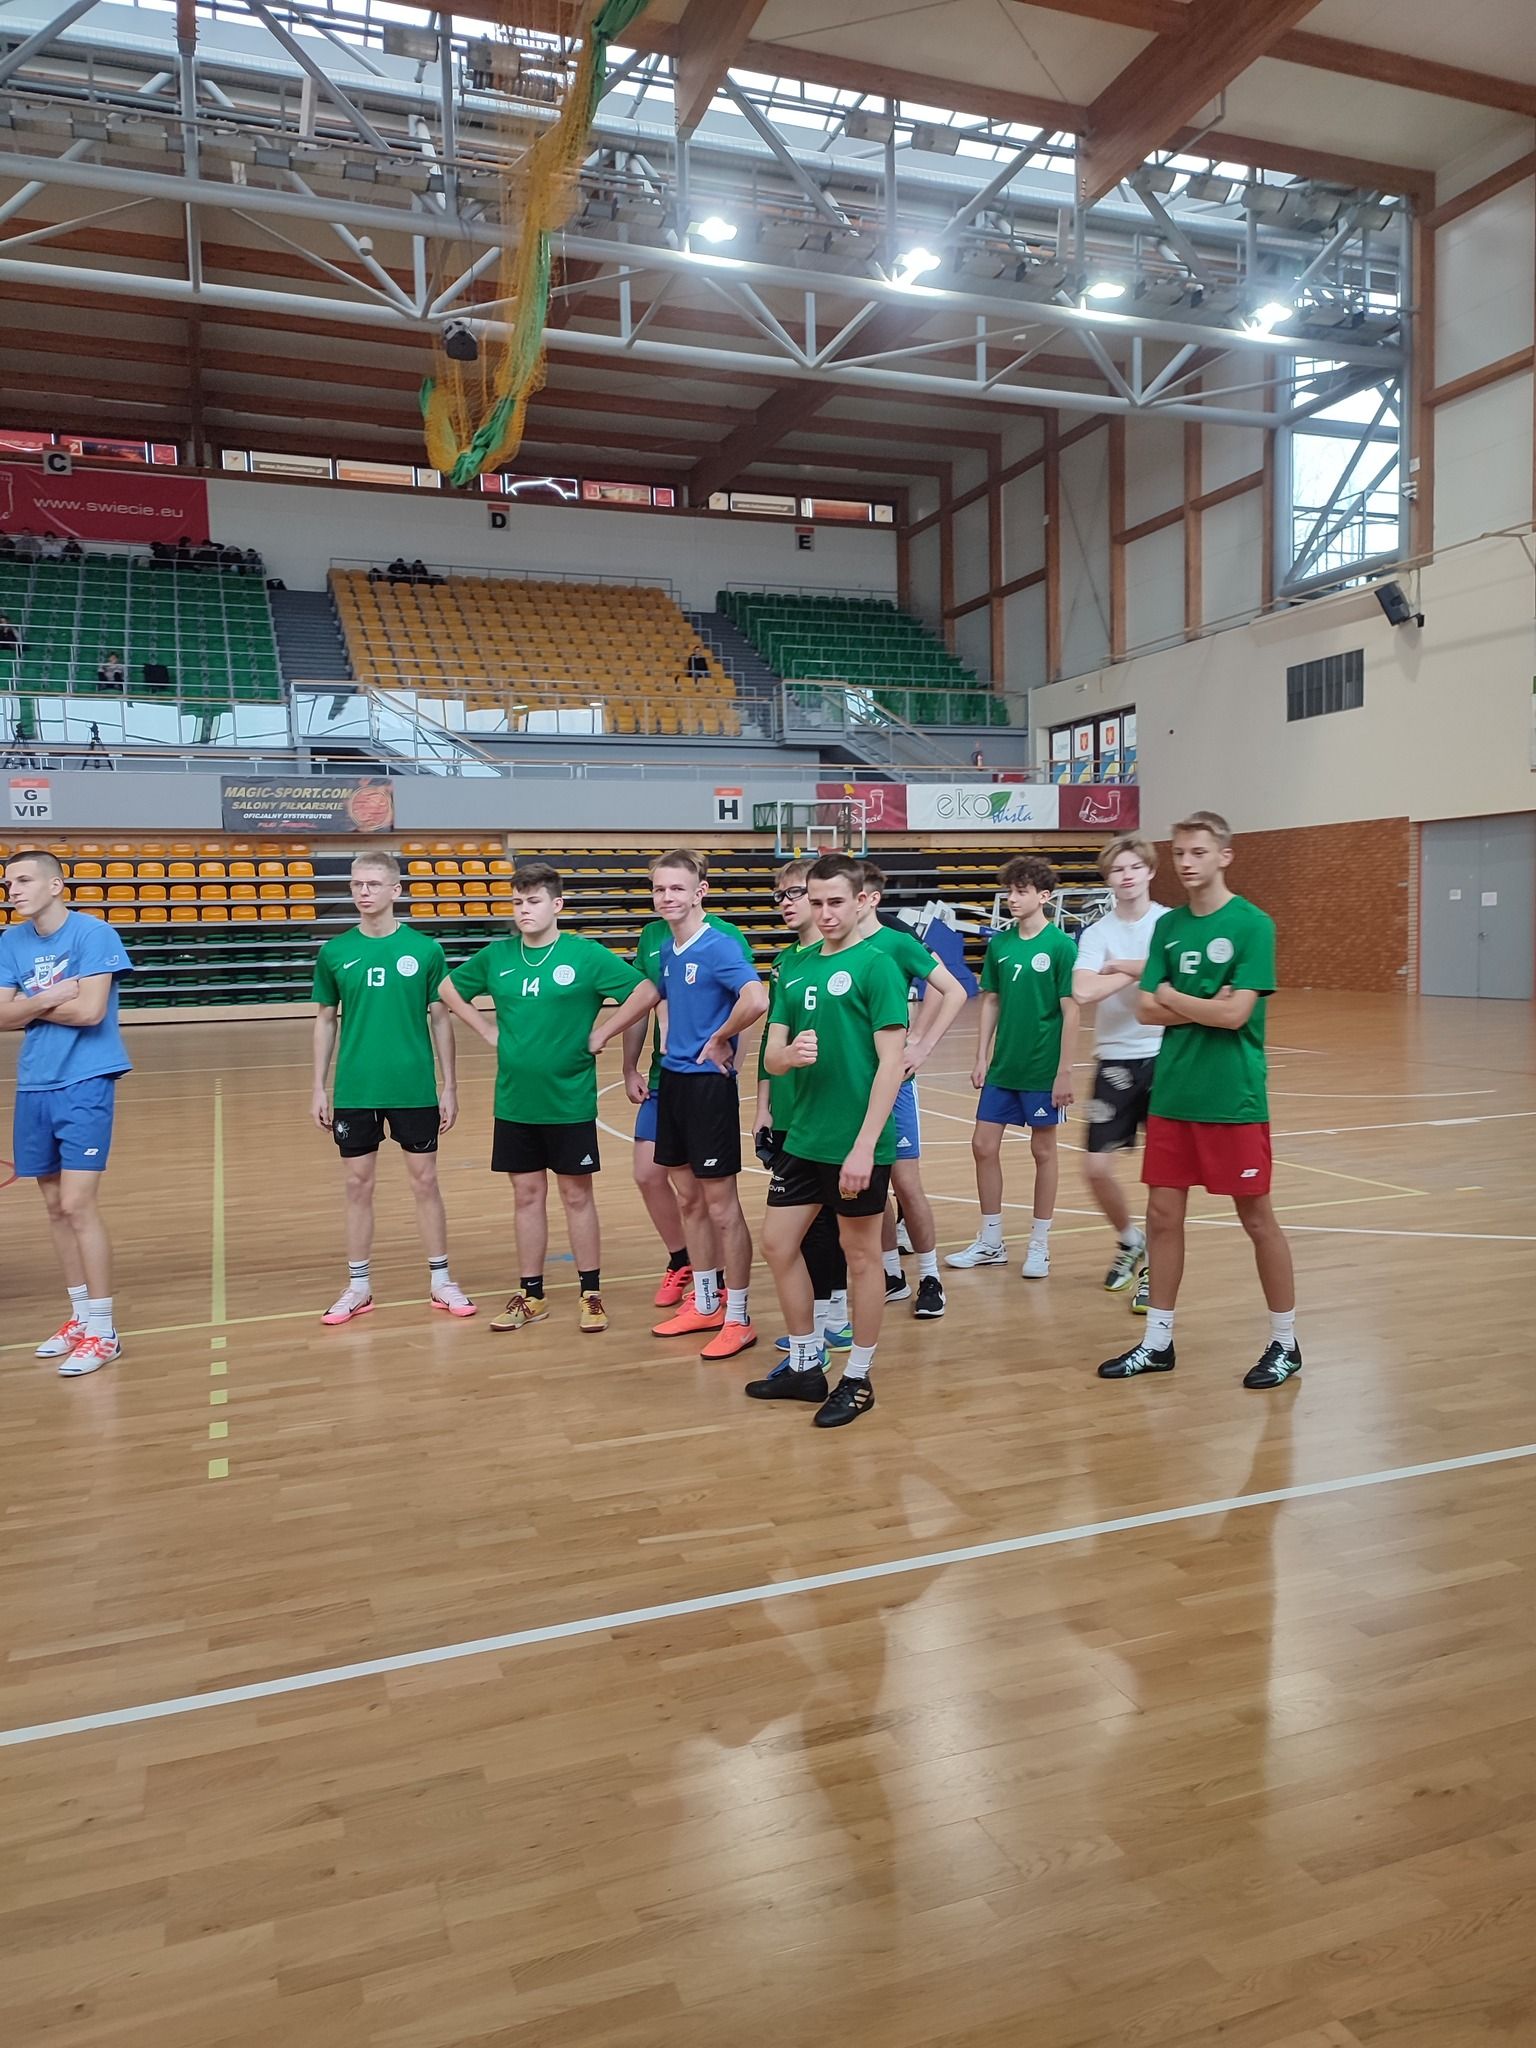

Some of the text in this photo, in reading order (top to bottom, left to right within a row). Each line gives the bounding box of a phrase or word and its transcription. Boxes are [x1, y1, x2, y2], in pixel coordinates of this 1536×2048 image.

[48, 453, 67, 471] C
[33, 498, 184, 518] www.swiecie.eu
[491, 513, 507, 529] D
[799, 535, 811, 549] E
[24, 789, 38, 801] G
[224, 787, 354, 799] MAGIC-SPORT.COM
[14, 805, 48, 817] VIP
[231, 801, 277, 810] SALONY
[719, 799, 739, 820] H
[936, 788, 993, 819] eko
[367, 967, 385, 987] 13
[1012, 963, 1023, 982] 7
[521, 976, 540, 997] 14
[804, 985, 818, 1011] 6
